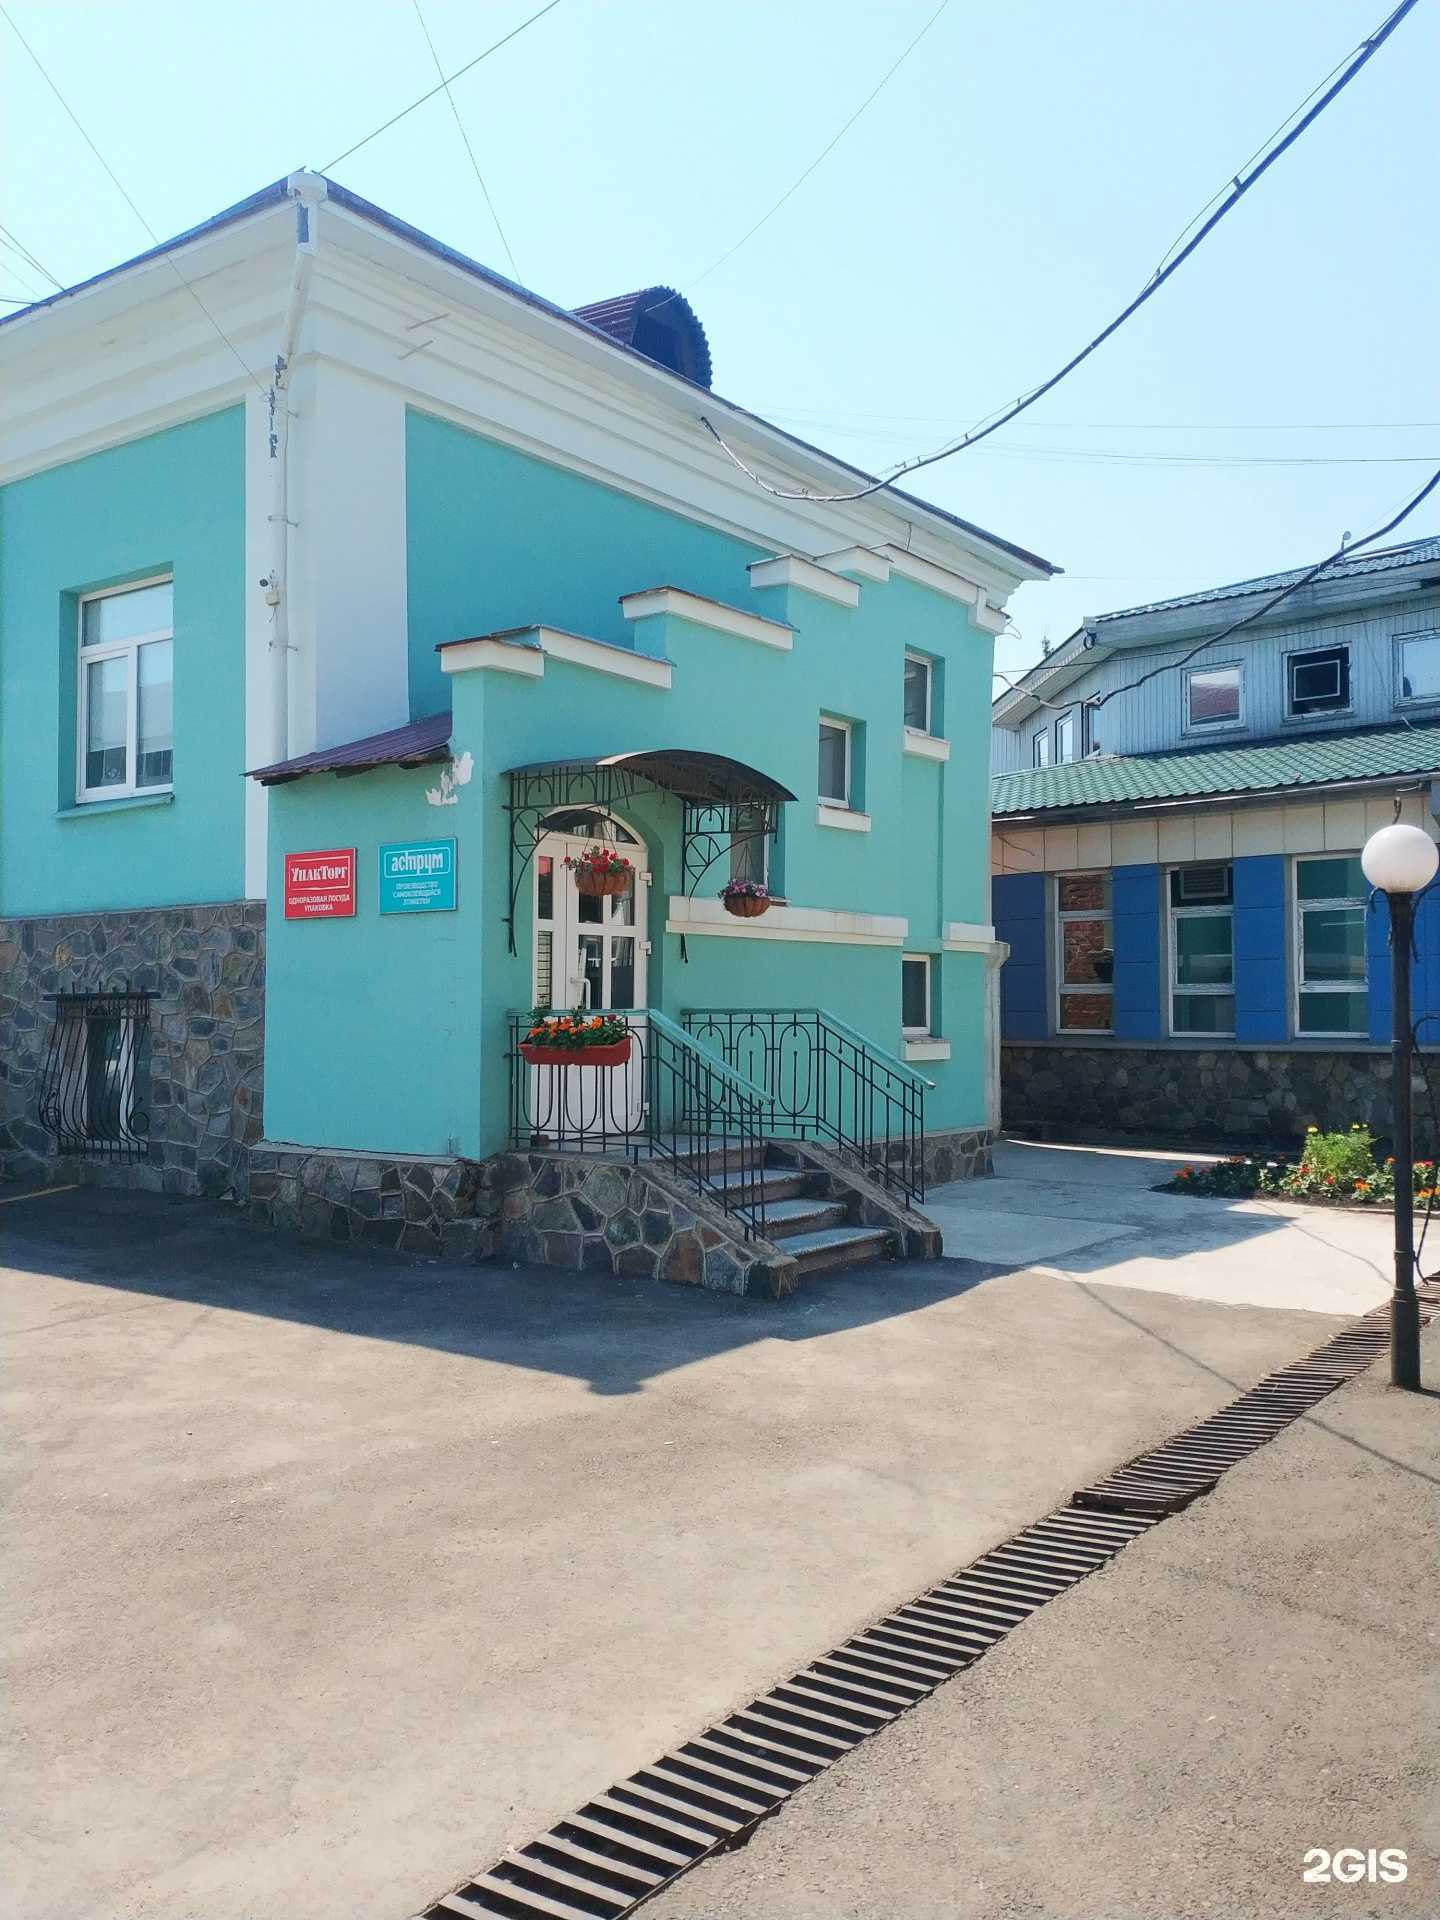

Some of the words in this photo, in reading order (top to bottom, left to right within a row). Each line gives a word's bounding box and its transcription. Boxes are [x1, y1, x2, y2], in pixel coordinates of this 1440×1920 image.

[288, 895, 328, 905] ОДНОРАЗОВАЯ
[328, 893, 351, 903] ПОСУДА
[304, 903, 334, 913] УПАКОВКА
